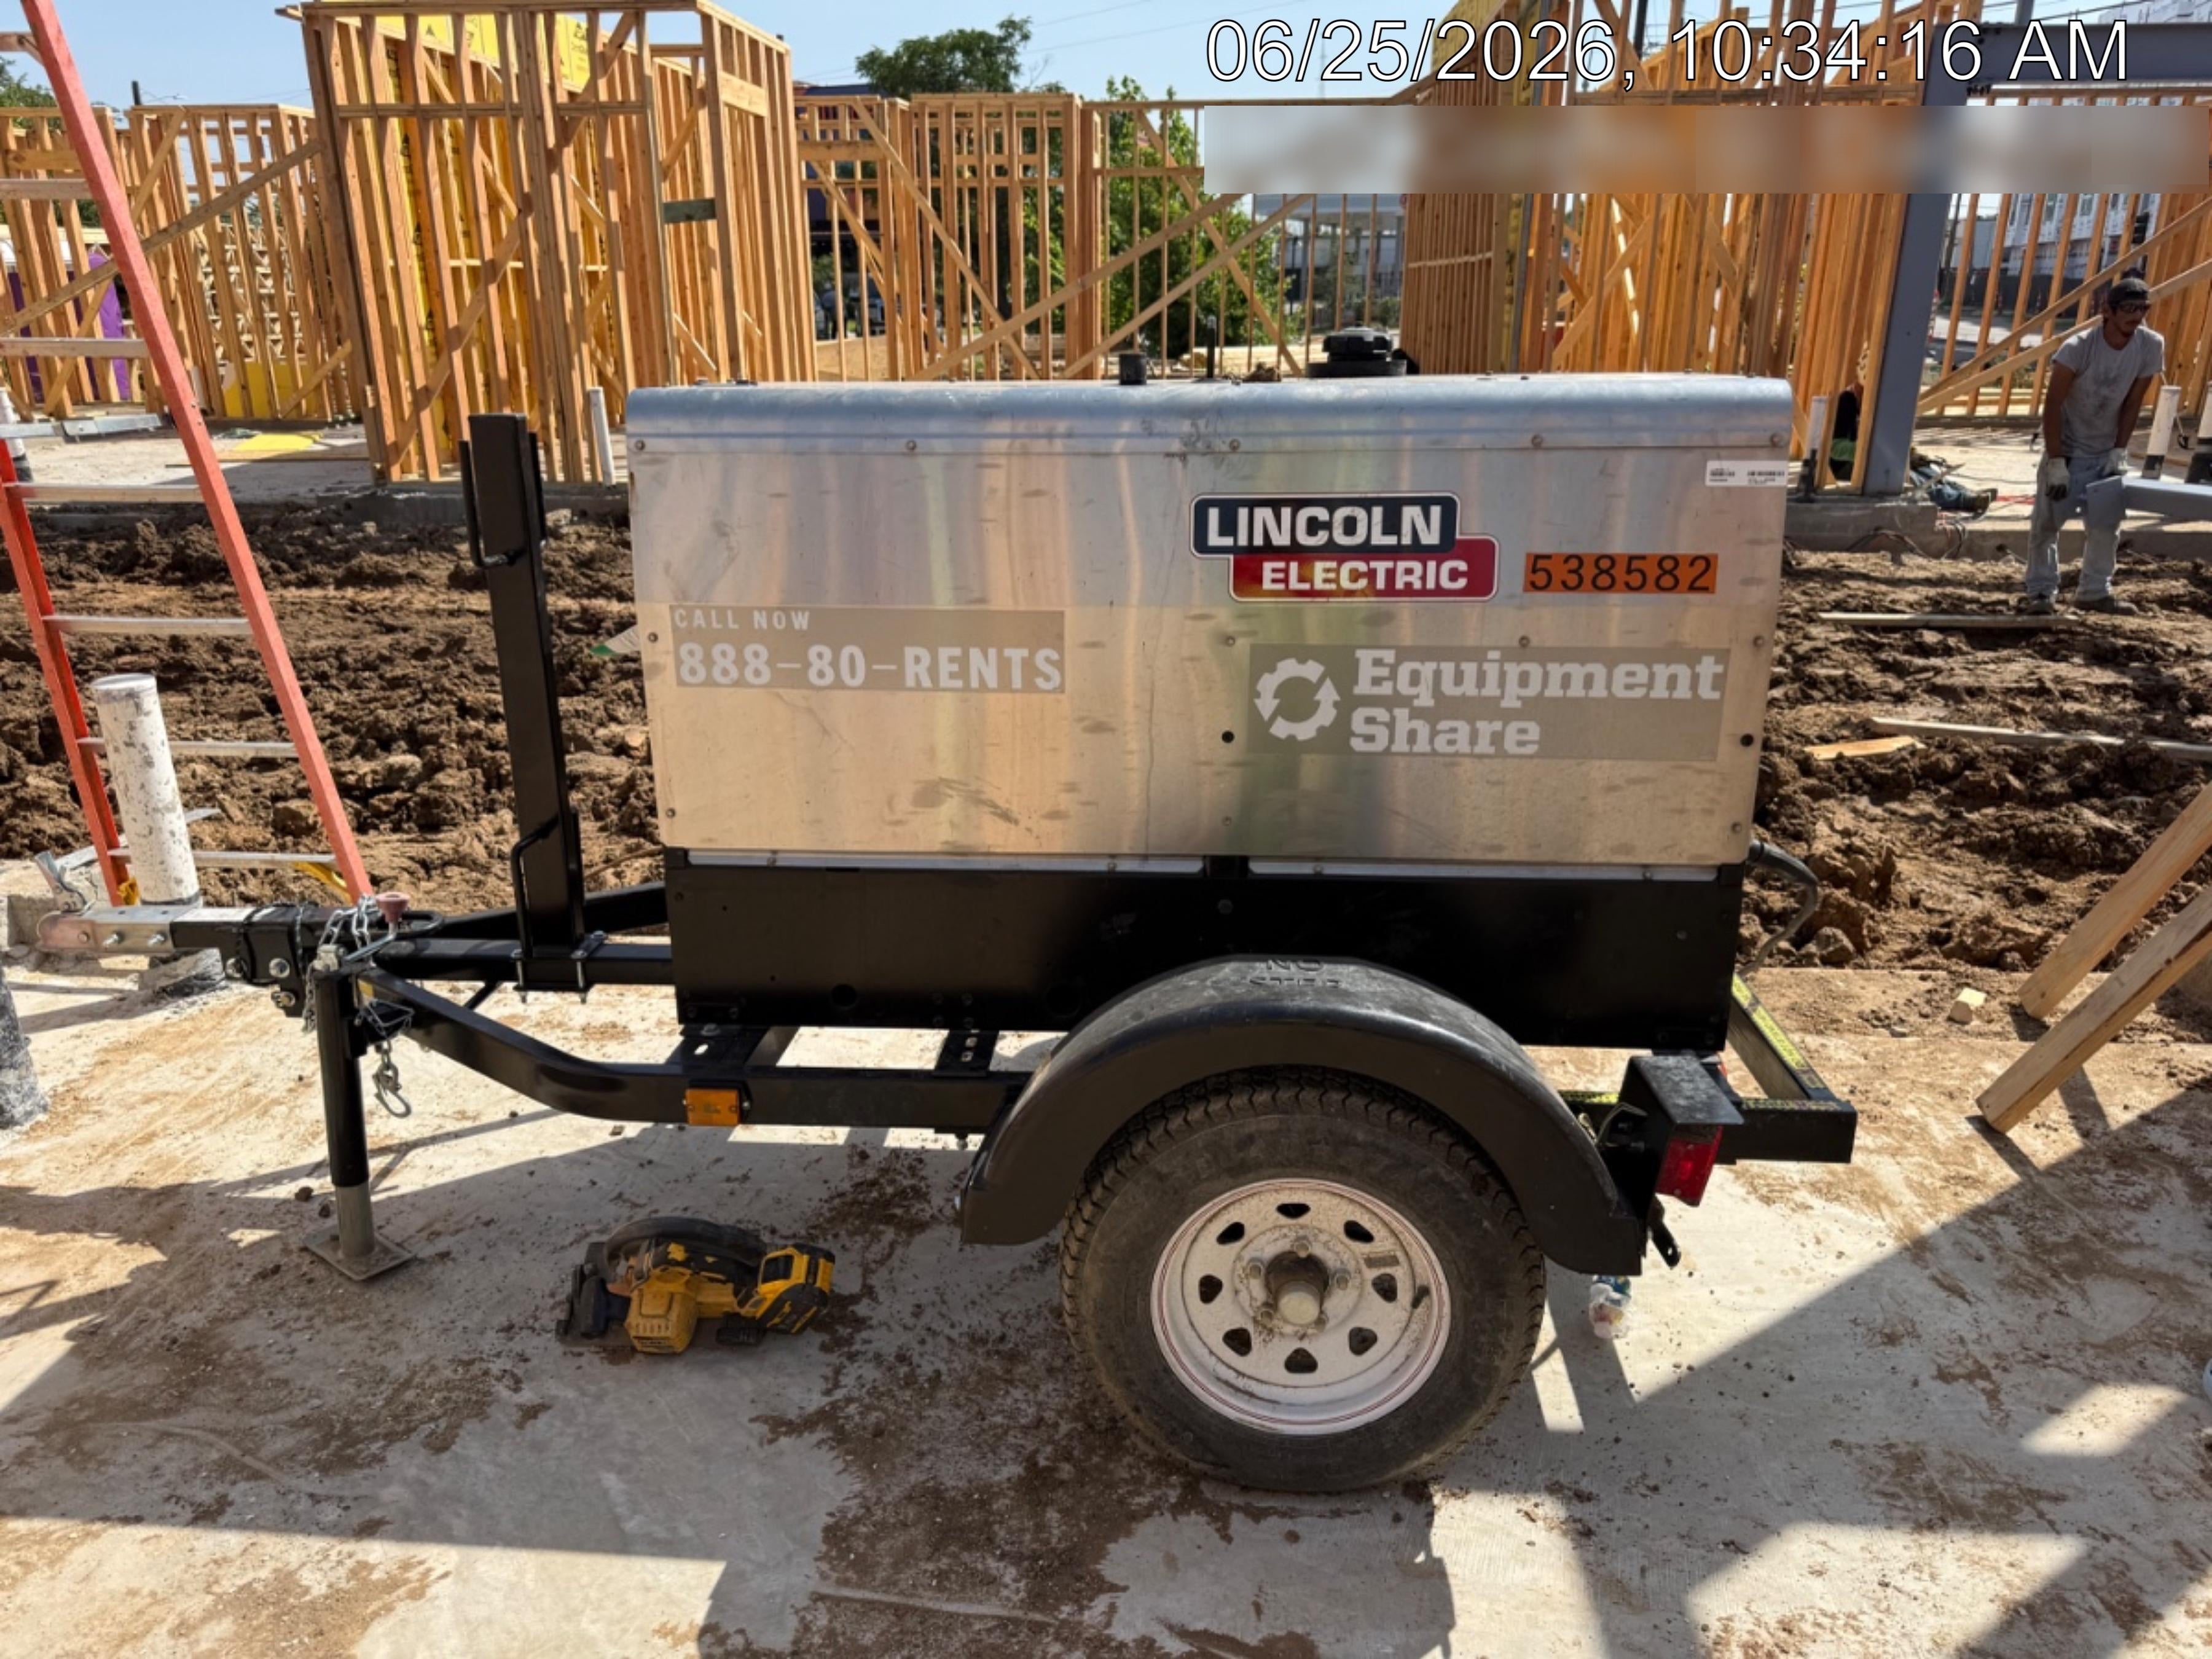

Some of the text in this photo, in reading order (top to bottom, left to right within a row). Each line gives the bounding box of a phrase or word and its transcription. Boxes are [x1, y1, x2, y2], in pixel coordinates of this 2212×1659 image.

[1207, 504, 1441, 547] LINCOLN
[1261, 560, 1469, 591] ELECTRIC
[1529, 554, 1712, 592] 538582
[674, 608, 811, 631] CALL NOW
[678, 642, 1062, 689] 888-80-RENTS
[1353, 649, 1724, 708] Equipment
[1349, 707, 1540, 755] Share
